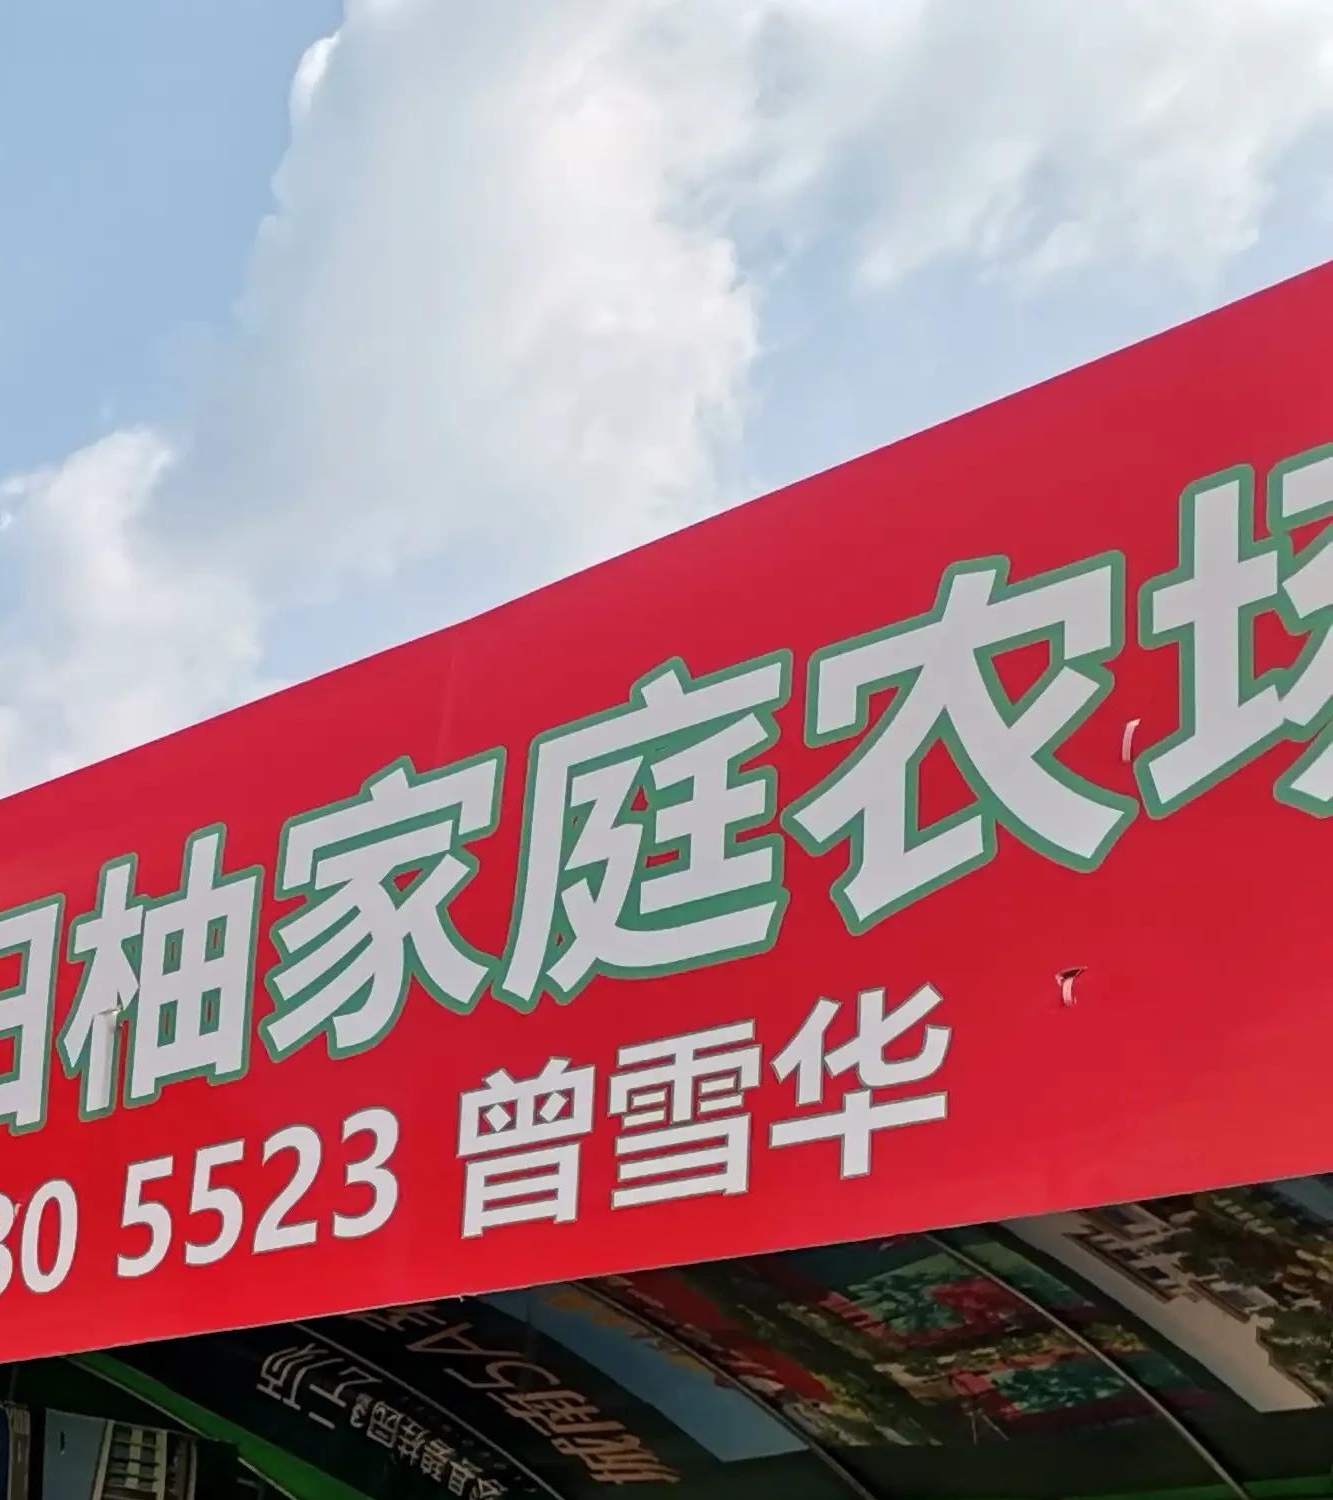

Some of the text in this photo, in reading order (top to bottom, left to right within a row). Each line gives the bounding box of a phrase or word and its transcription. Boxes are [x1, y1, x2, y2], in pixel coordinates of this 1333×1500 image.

[116, 1106, 401, 1279] 5523
[455, 981, 953, 1238] 曾雪华
